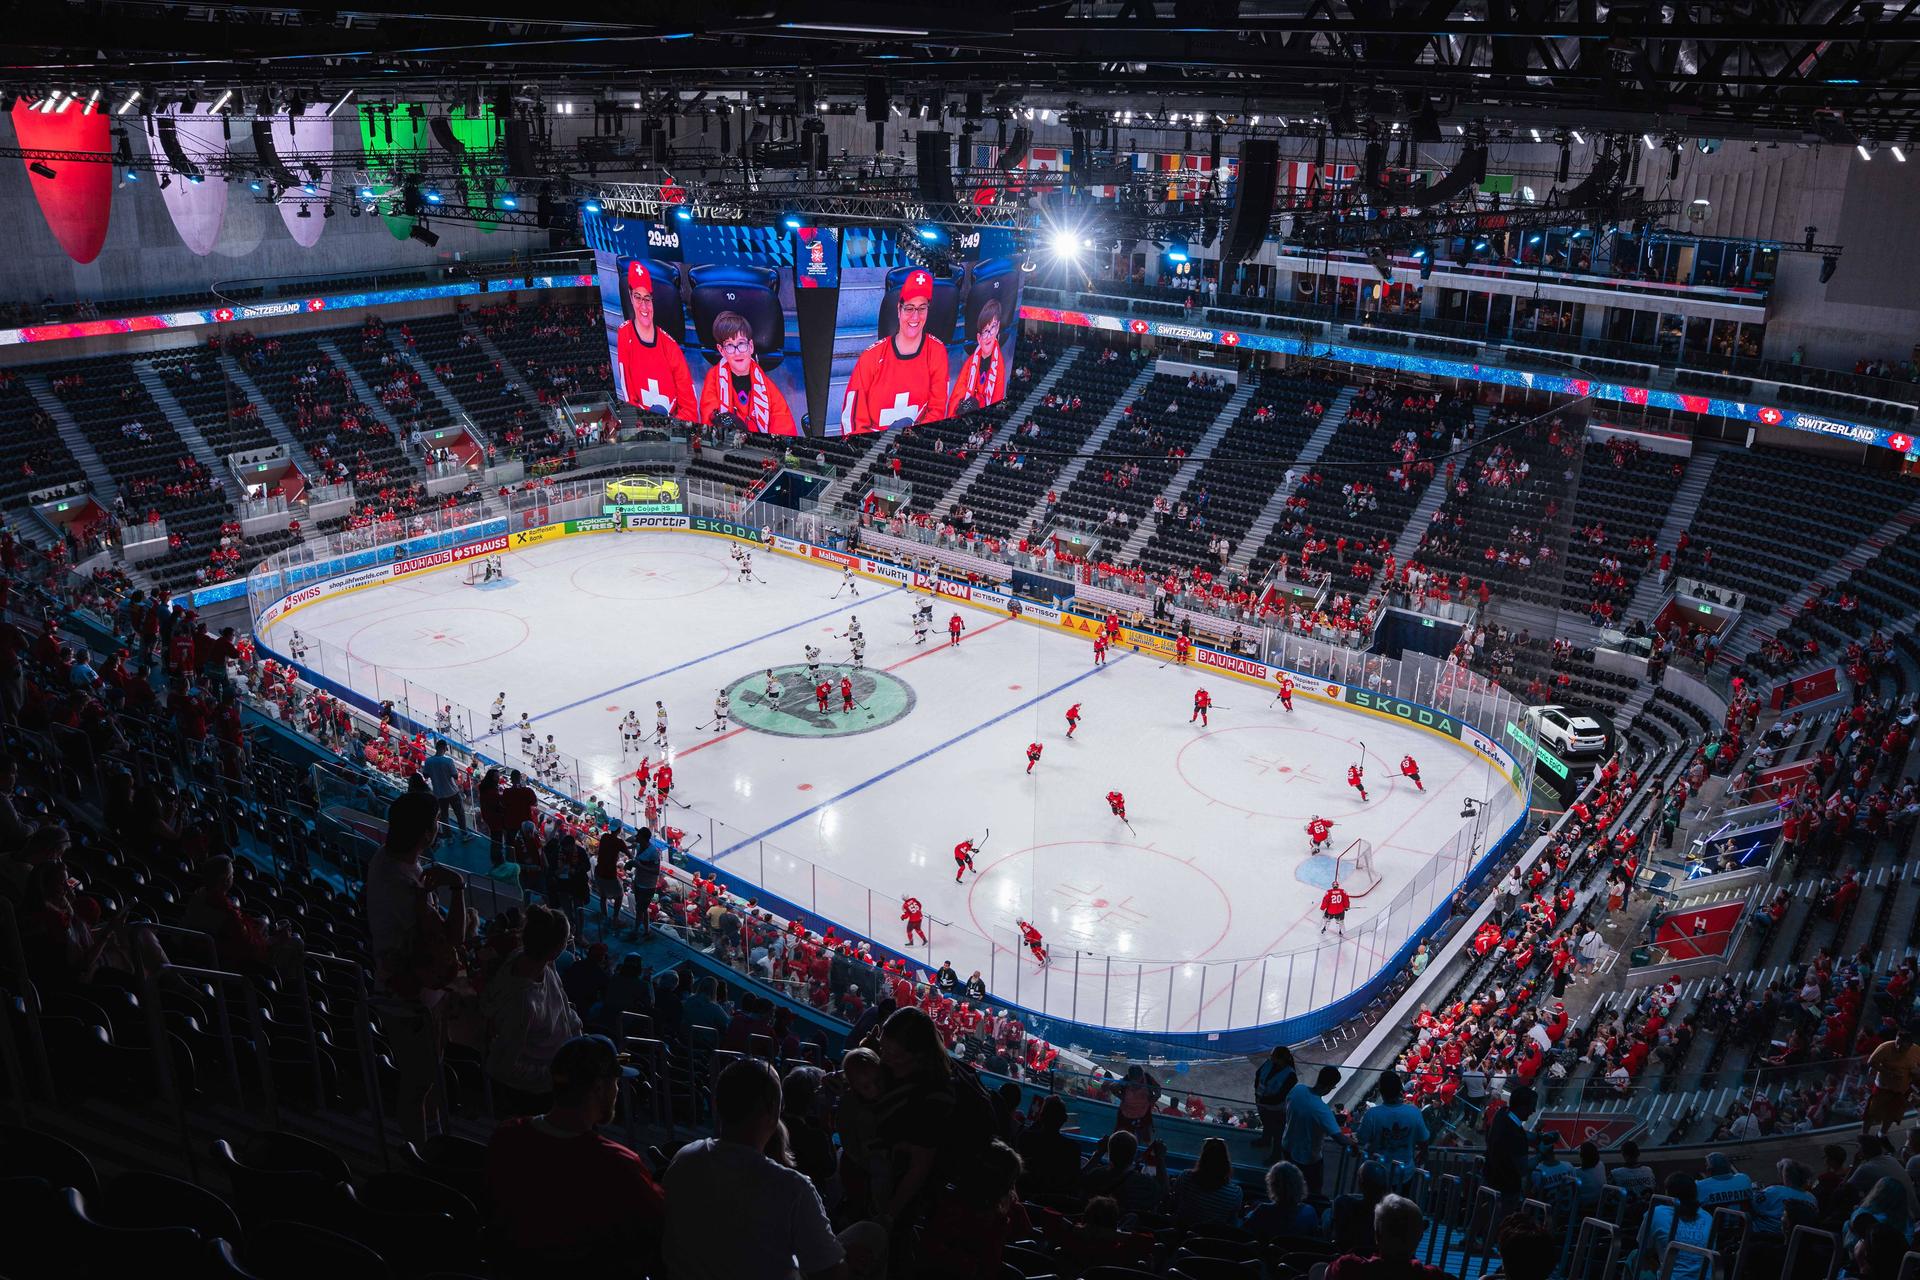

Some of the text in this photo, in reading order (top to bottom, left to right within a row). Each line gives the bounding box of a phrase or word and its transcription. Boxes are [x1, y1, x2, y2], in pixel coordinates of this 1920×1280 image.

[648, 230, 679, 248] 29:49
[1158, 325, 1214, 340] SWITZERLAND
[1797, 417, 1874, 441] SWITZERLAND
[577, 523, 614, 531] TYRES
[464, 537, 507, 557] STRAUSS
[393, 552, 450, 575] BAUHAUS
[292, 587, 321, 605] SWISS
[981, 593, 1005, 604] TISSOT
[1034, 607, 1059, 619] TISSOT
[1199, 649, 1266, 677] BAUHAUS
[1314, 824, 1325, 834] 63
[1331, 894, 1342, 904] 20
